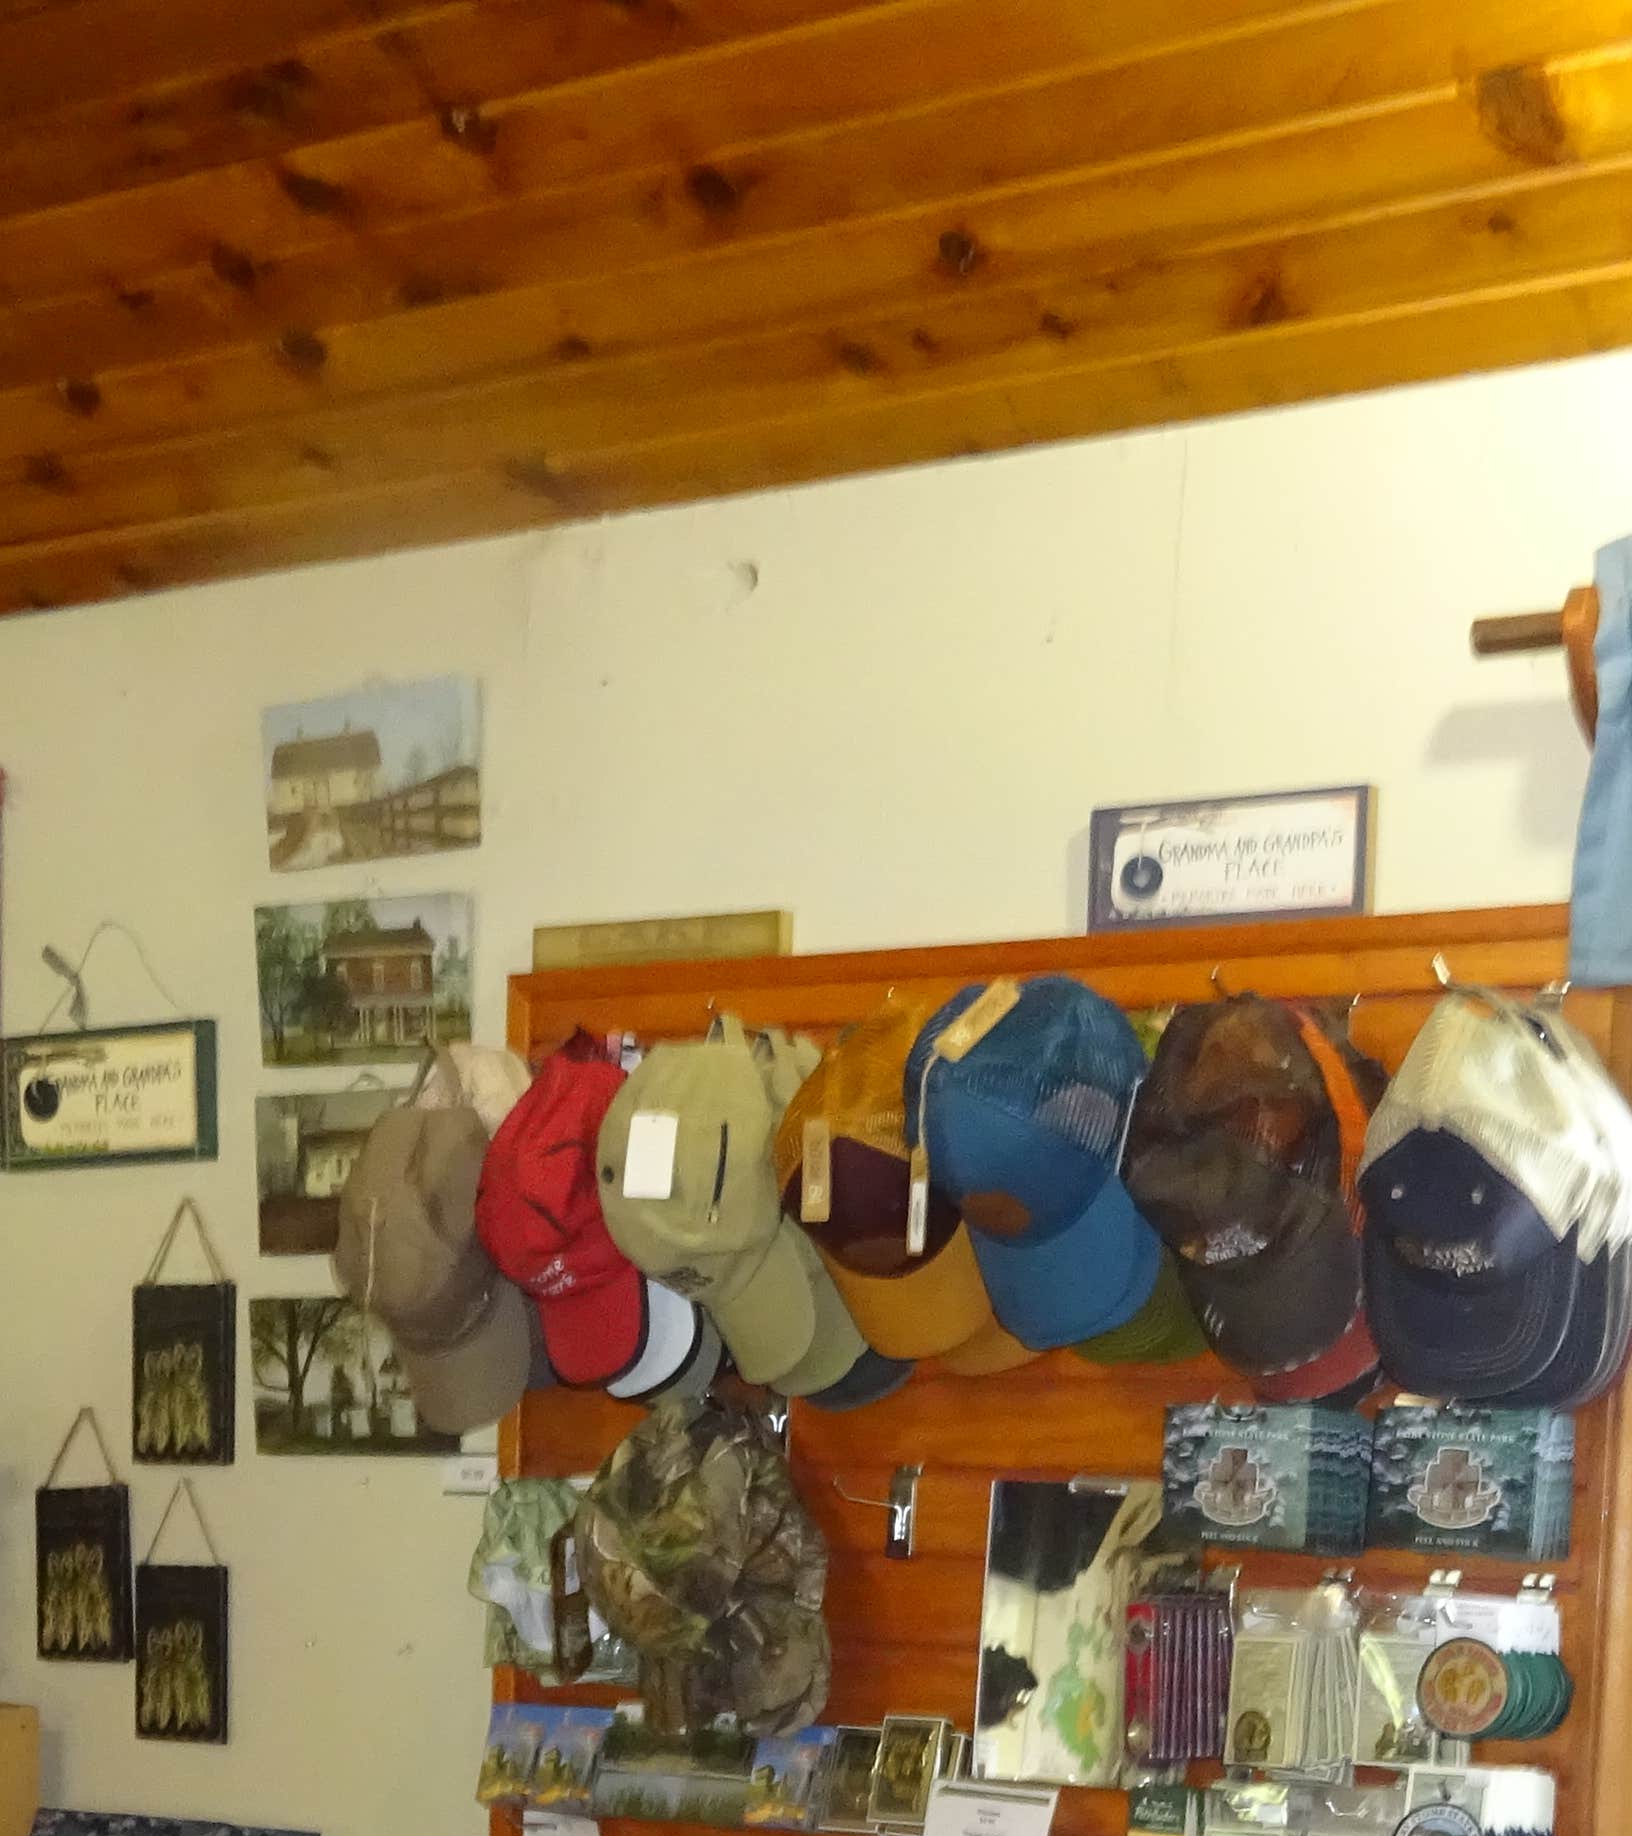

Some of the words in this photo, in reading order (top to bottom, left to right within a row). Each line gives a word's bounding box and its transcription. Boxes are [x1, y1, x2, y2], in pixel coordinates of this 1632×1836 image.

[1159, 840, 1228, 867] GRANDMA
[1234, 840, 1257, 856] AND
[1225, 859, 1280, 883] PLACE
